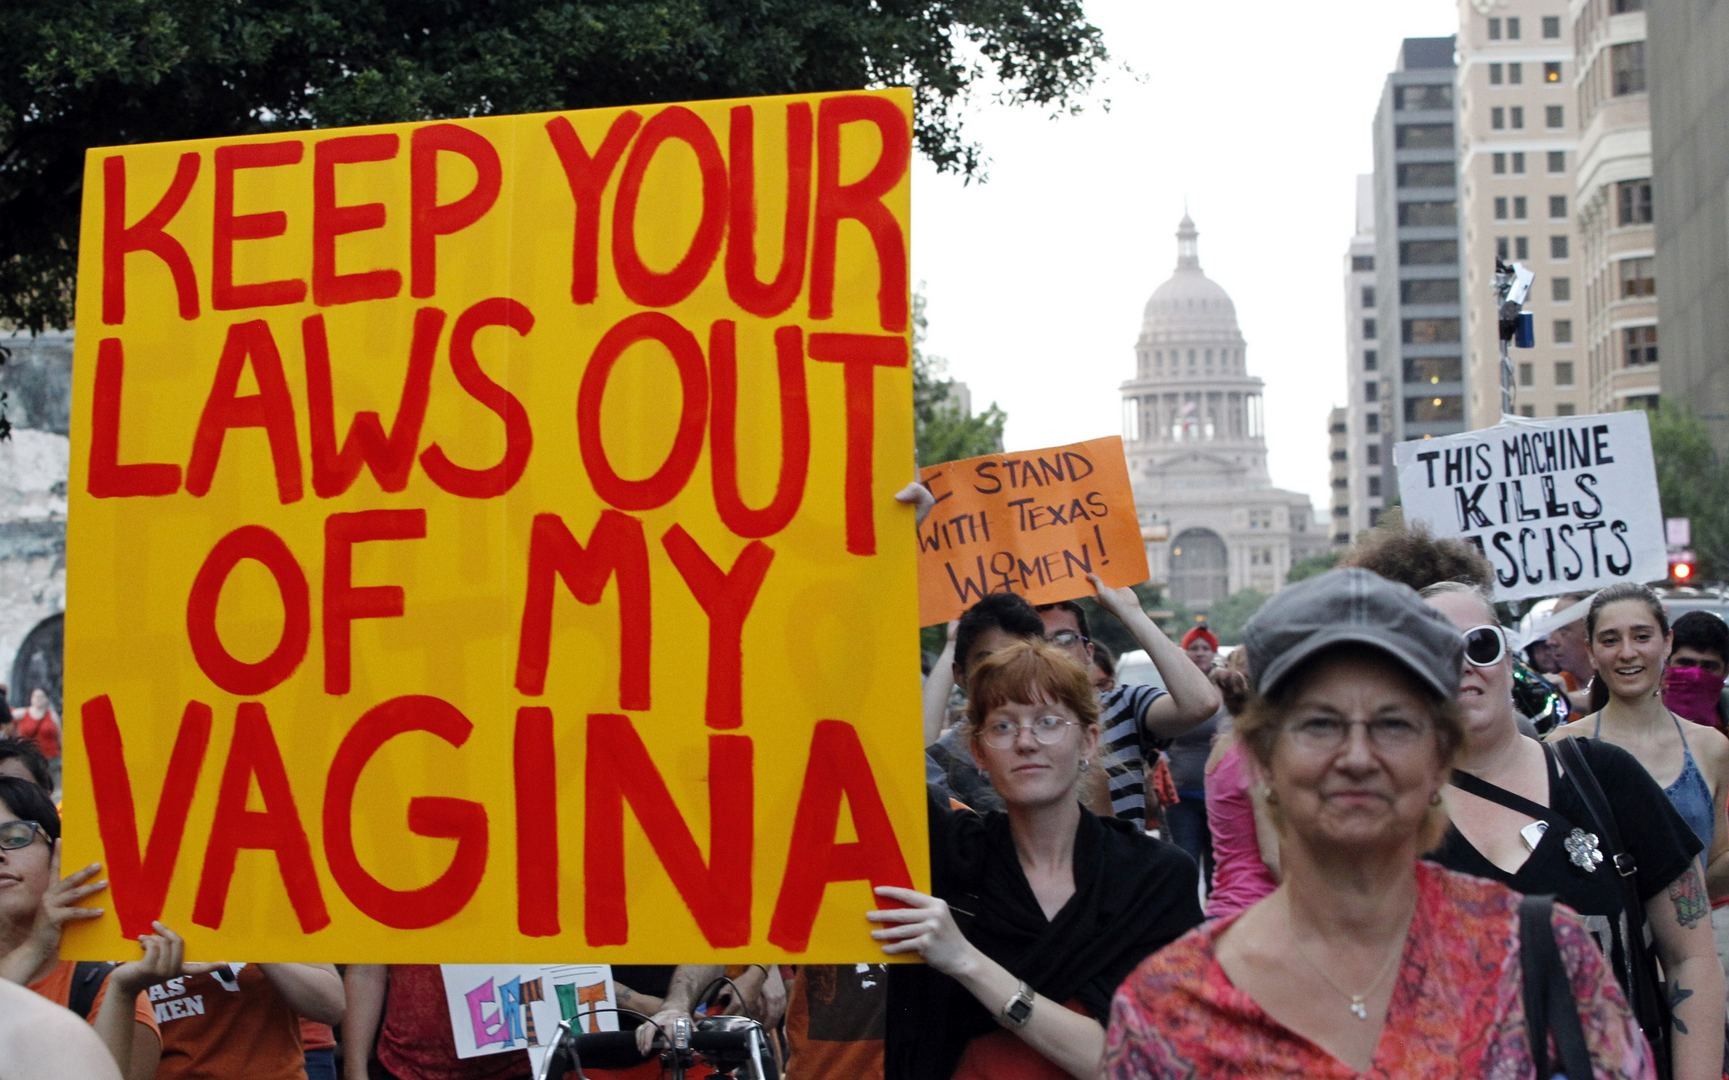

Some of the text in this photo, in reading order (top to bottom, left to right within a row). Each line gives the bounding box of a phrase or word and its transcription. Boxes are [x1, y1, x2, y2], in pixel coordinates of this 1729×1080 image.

[102, 94, 911, 332] KEEP YOUR
[87, 297, 909, 556] LAWS OUT
[1417, 425, 1615, 488] THIS MACHINE
[973, 452, 1094, 494] STAND
[1454, 473, 1603, 532] KILLS
[917, 491, 1109, 554] WITH TEXAS
[1464, 519, 1632, 588] SCISTS
[186, 508, 774, 730] OF MY
[80, 694, 918, 953] VAGINA
[465, 975, 608, 1049] EAT IT
